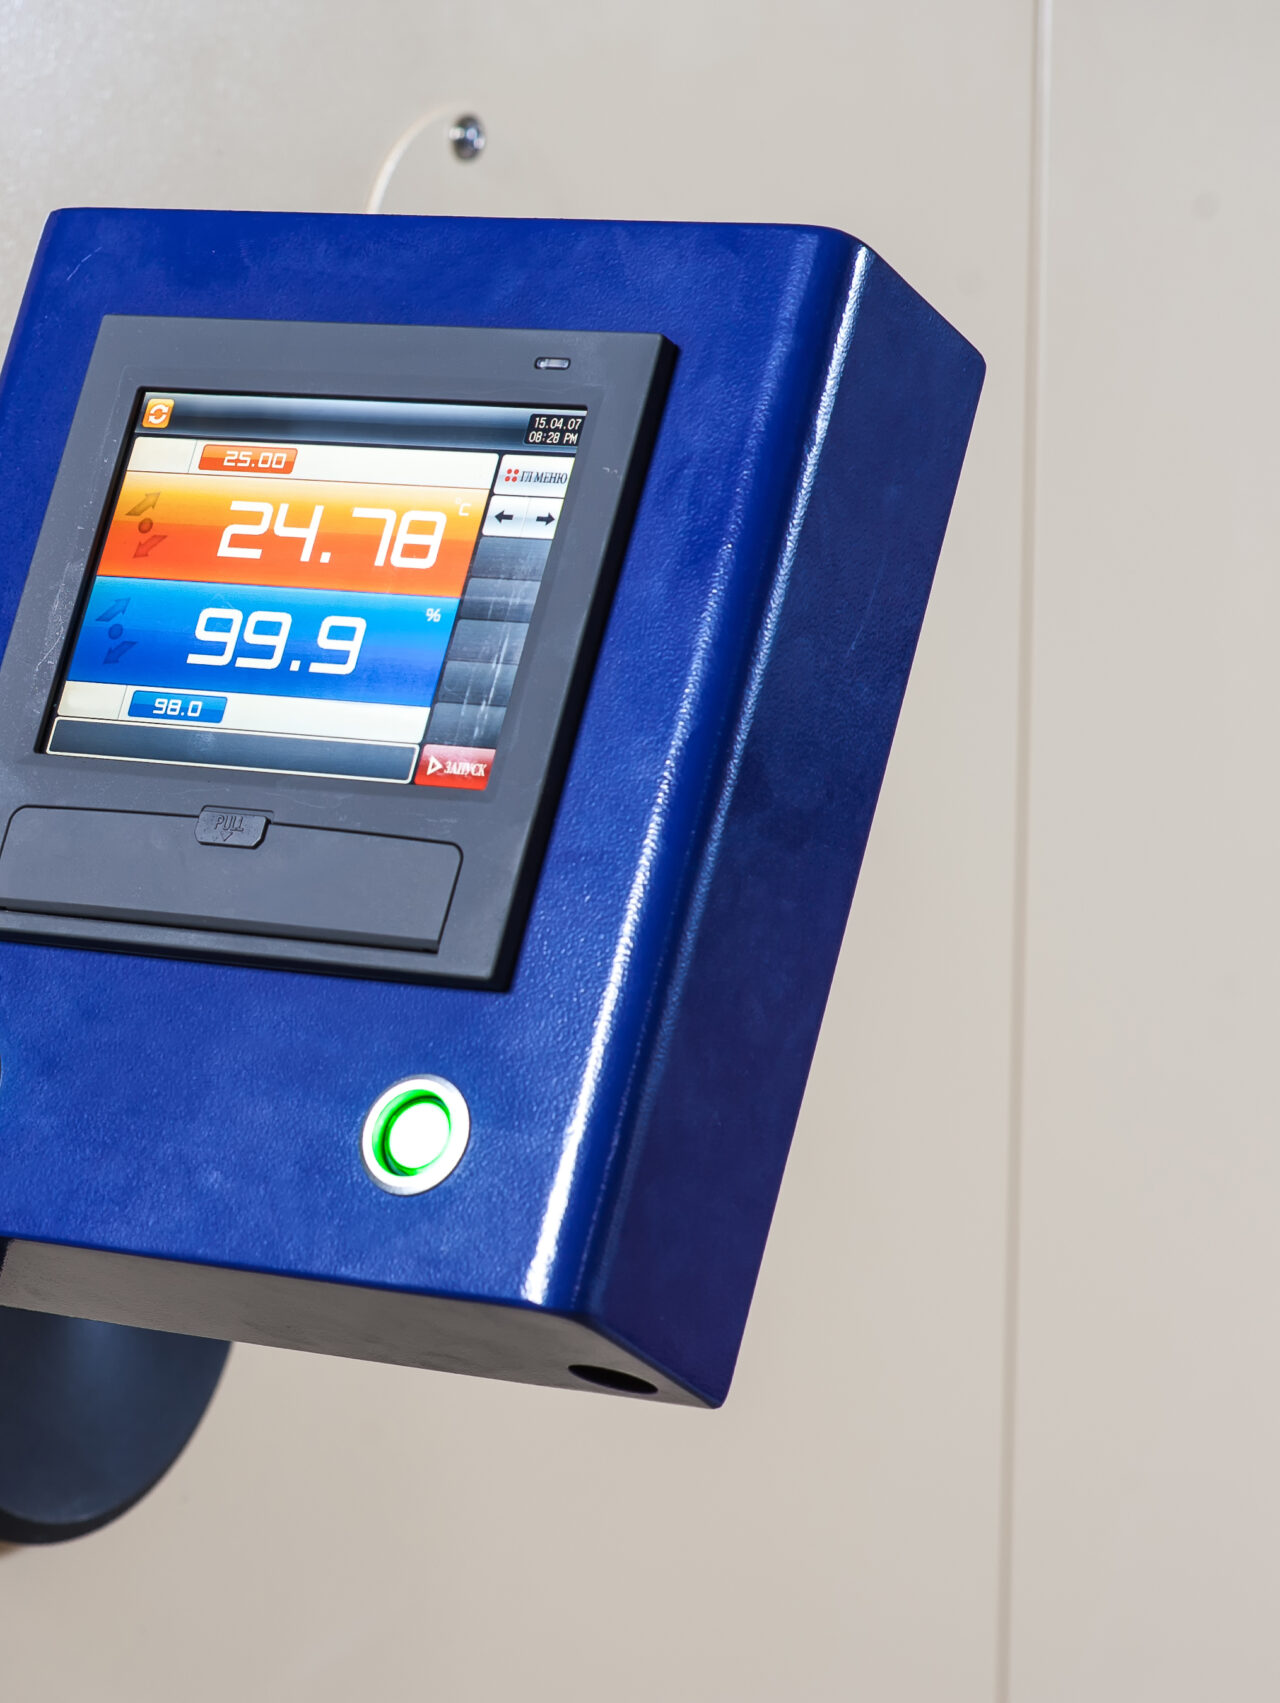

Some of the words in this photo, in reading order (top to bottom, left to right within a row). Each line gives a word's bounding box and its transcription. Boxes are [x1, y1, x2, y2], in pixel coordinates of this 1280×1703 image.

[534, 417, 582, 430] 15.04.07
[528, 431, 560, 443] 08:28
[563, 433, 578, 444] PM
[223, 451, 287, 469] 25.00
[533, 471, 568, 484] МЕНЮ
[217, 501, 447, 569] 24.78
[425, 608, 441, 622] %
[187, 608, 367, 675] 99.9
[153, 698, 203, 717] 98.0
[444, 760, 487, 777] ЗАПУСК
[214, 815, 245, 832] PULL
